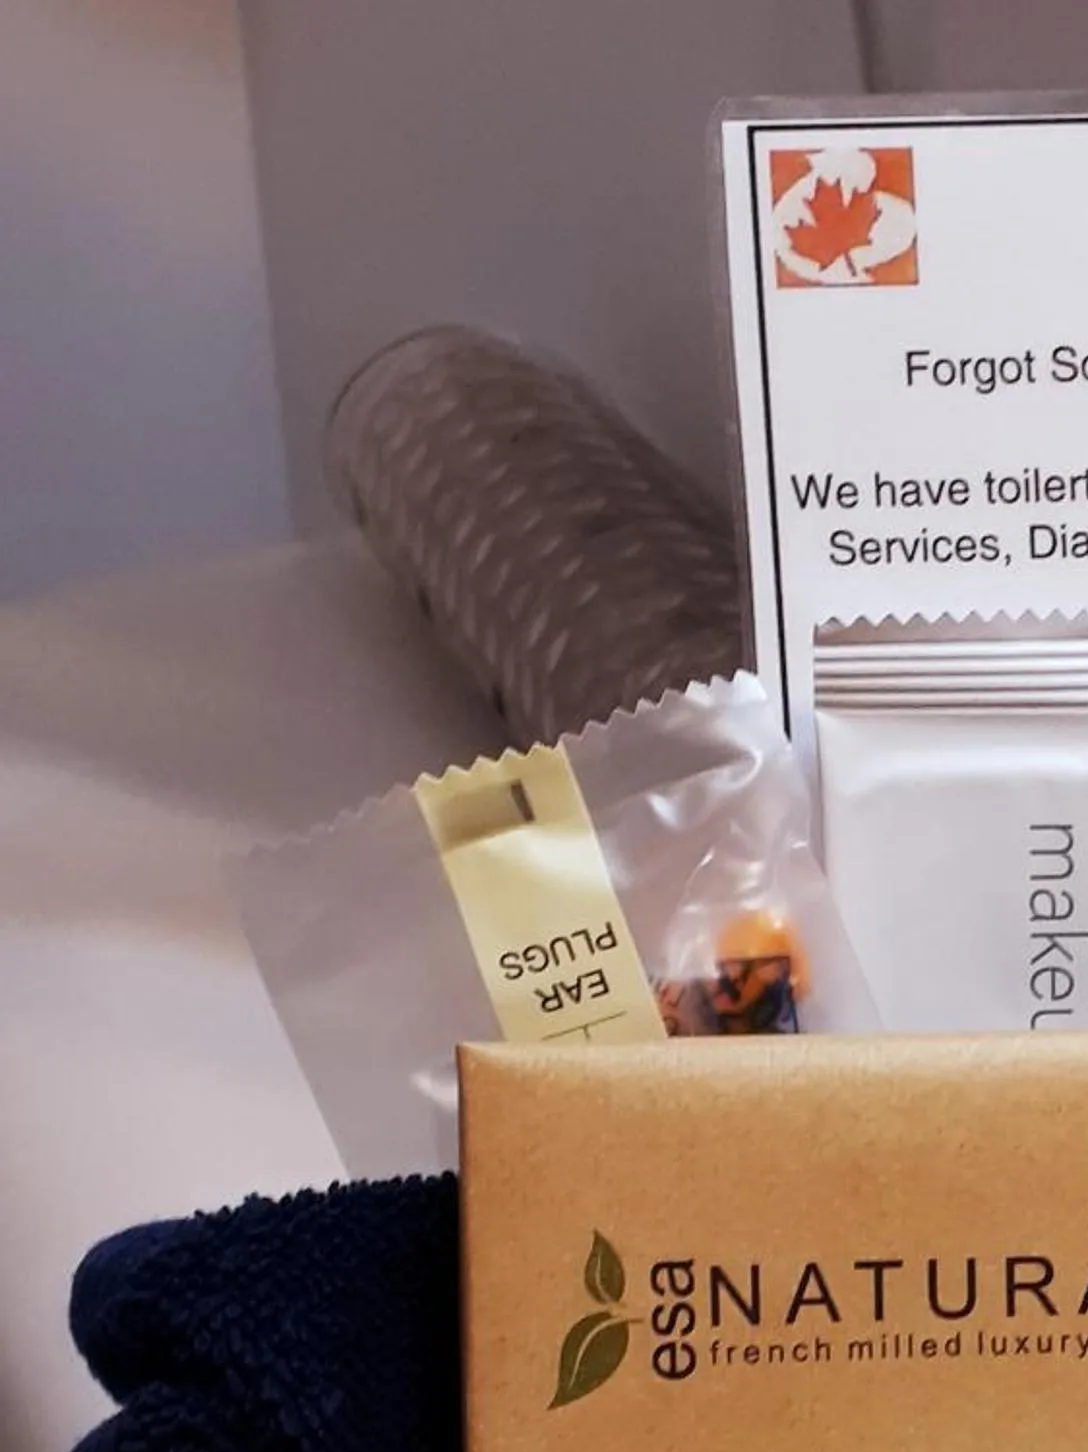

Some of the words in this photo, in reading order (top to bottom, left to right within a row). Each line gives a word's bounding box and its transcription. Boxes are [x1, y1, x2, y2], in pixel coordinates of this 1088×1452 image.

[905, 348, 1036, 395] Forgot
[791, 474, 859, 511] We
[874, 471, 970, 507] have
[829, 528, 1013, 568] Services,
[500, 922, 617, 981] PLUGS
[534, 969, 609, 1013] EAR
[651, 1259, 695, 1381] esa
[709, 1336, 832, 1366] french
[849, 1331, 961, 1361] milled
